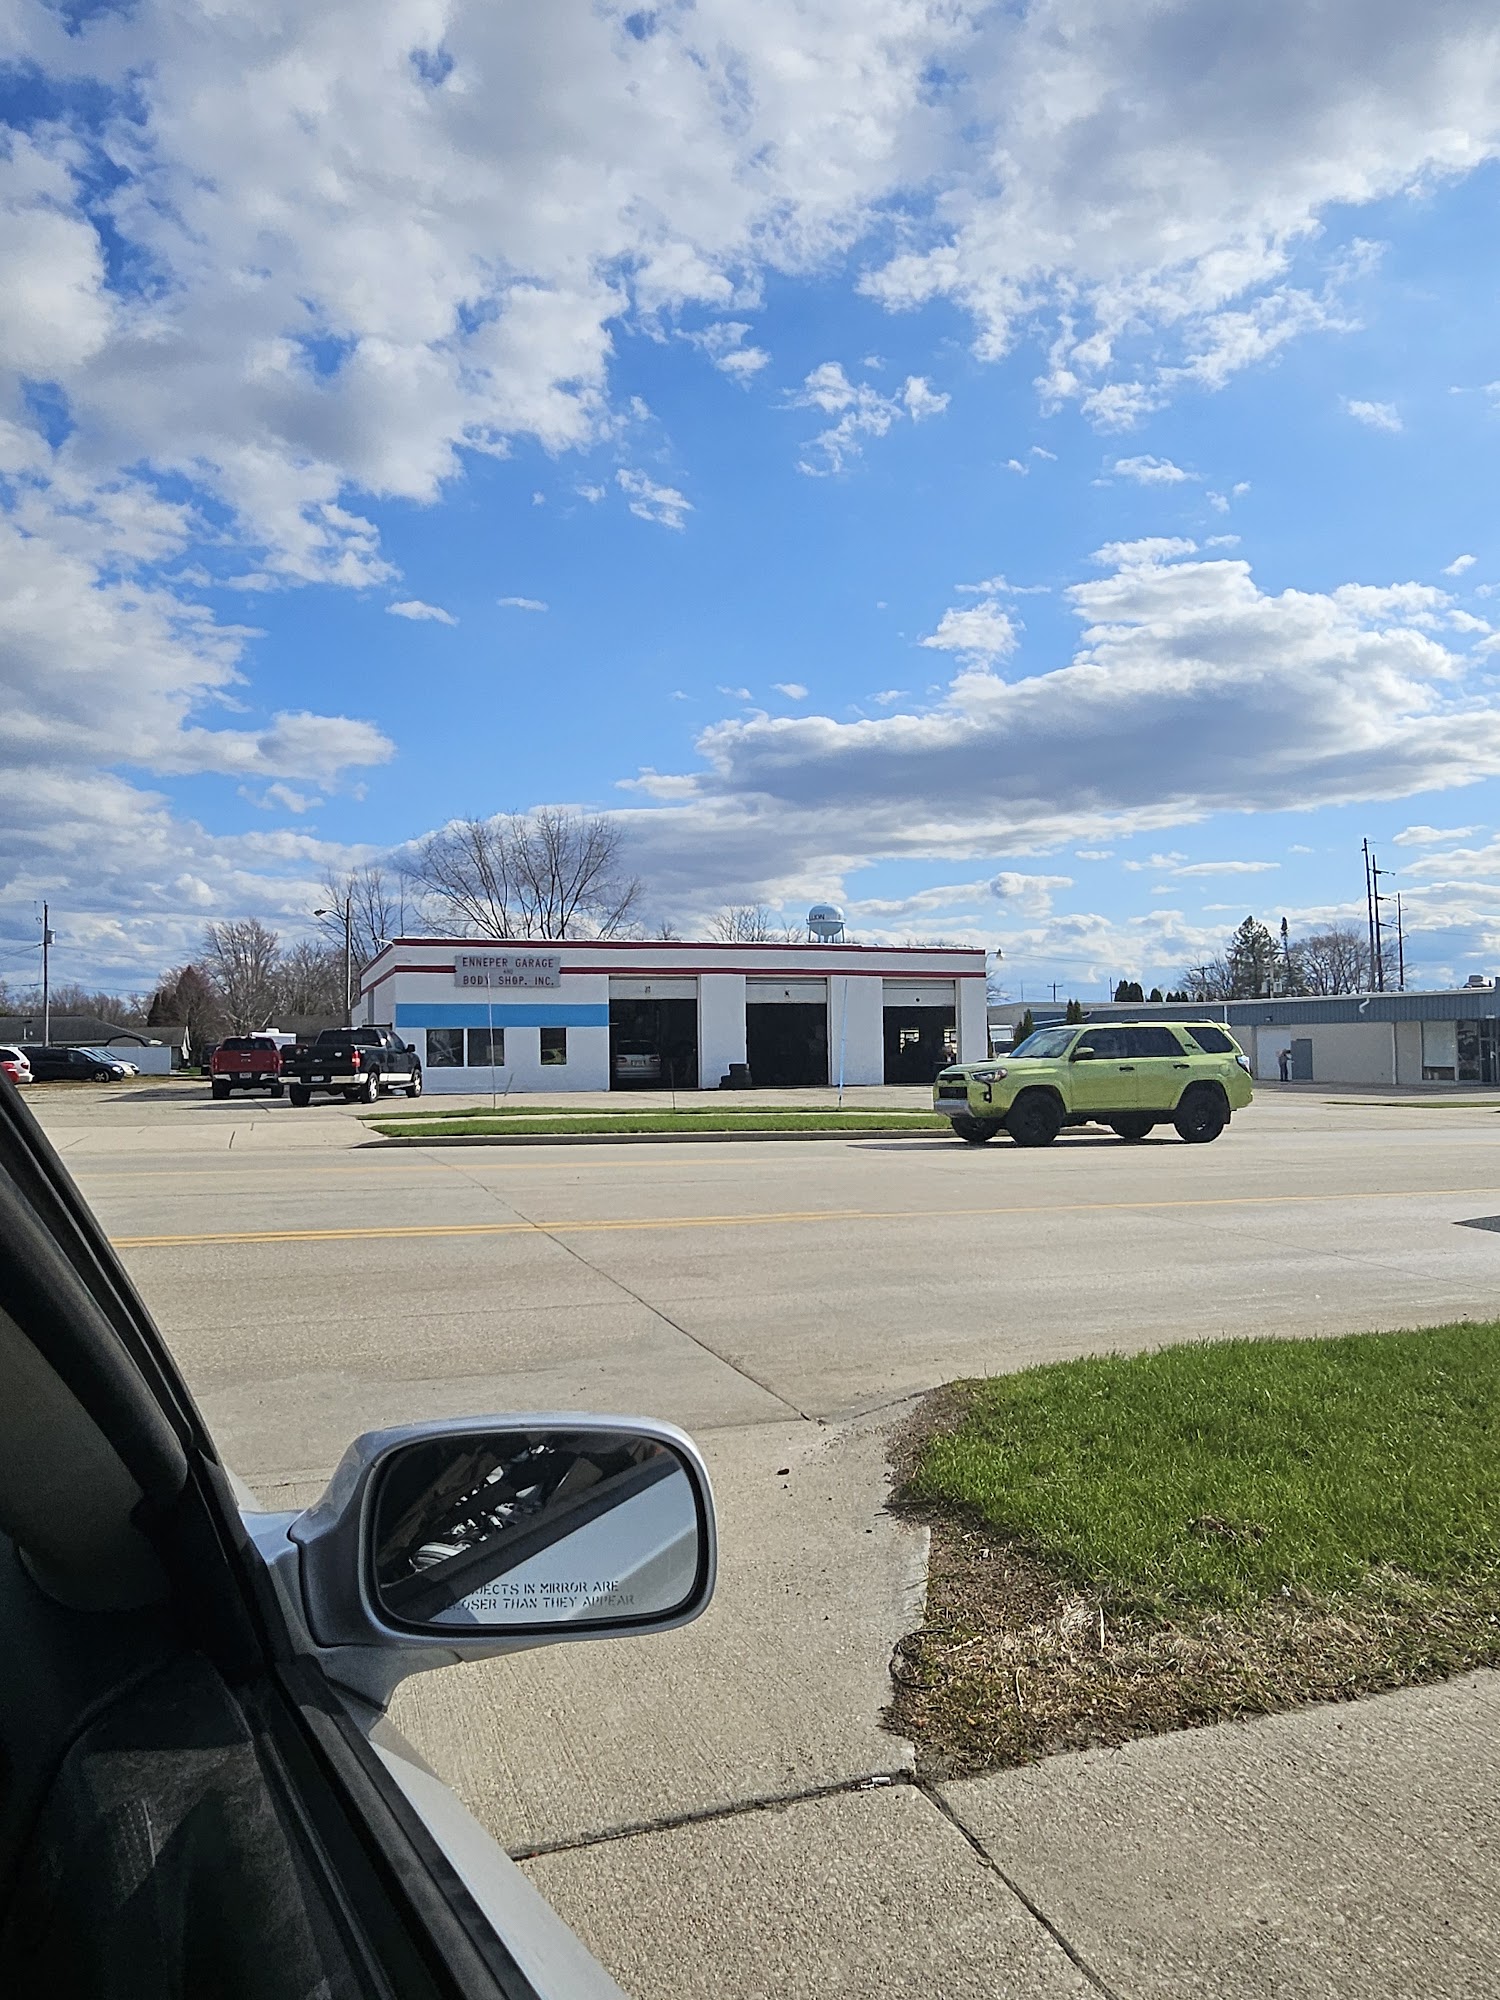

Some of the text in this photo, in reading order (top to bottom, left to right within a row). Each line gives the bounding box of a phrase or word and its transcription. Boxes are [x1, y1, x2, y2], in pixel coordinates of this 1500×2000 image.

[462, 957, 554, 968] ENNEPER GARAGE
[463, 975, 490, 985] BODY
[534, 976, 554, 986] INC.
[524, 1583, 535, 1595] IN
[540, 1582, 588, 1594] MIRROR
[593, 1581, 619, 1592] ARE
[503, 1598, 537, 1609] THAN
[543, 1596, 577, 1608] THEY
[582, 1595, 635, 1607] APPEAR
